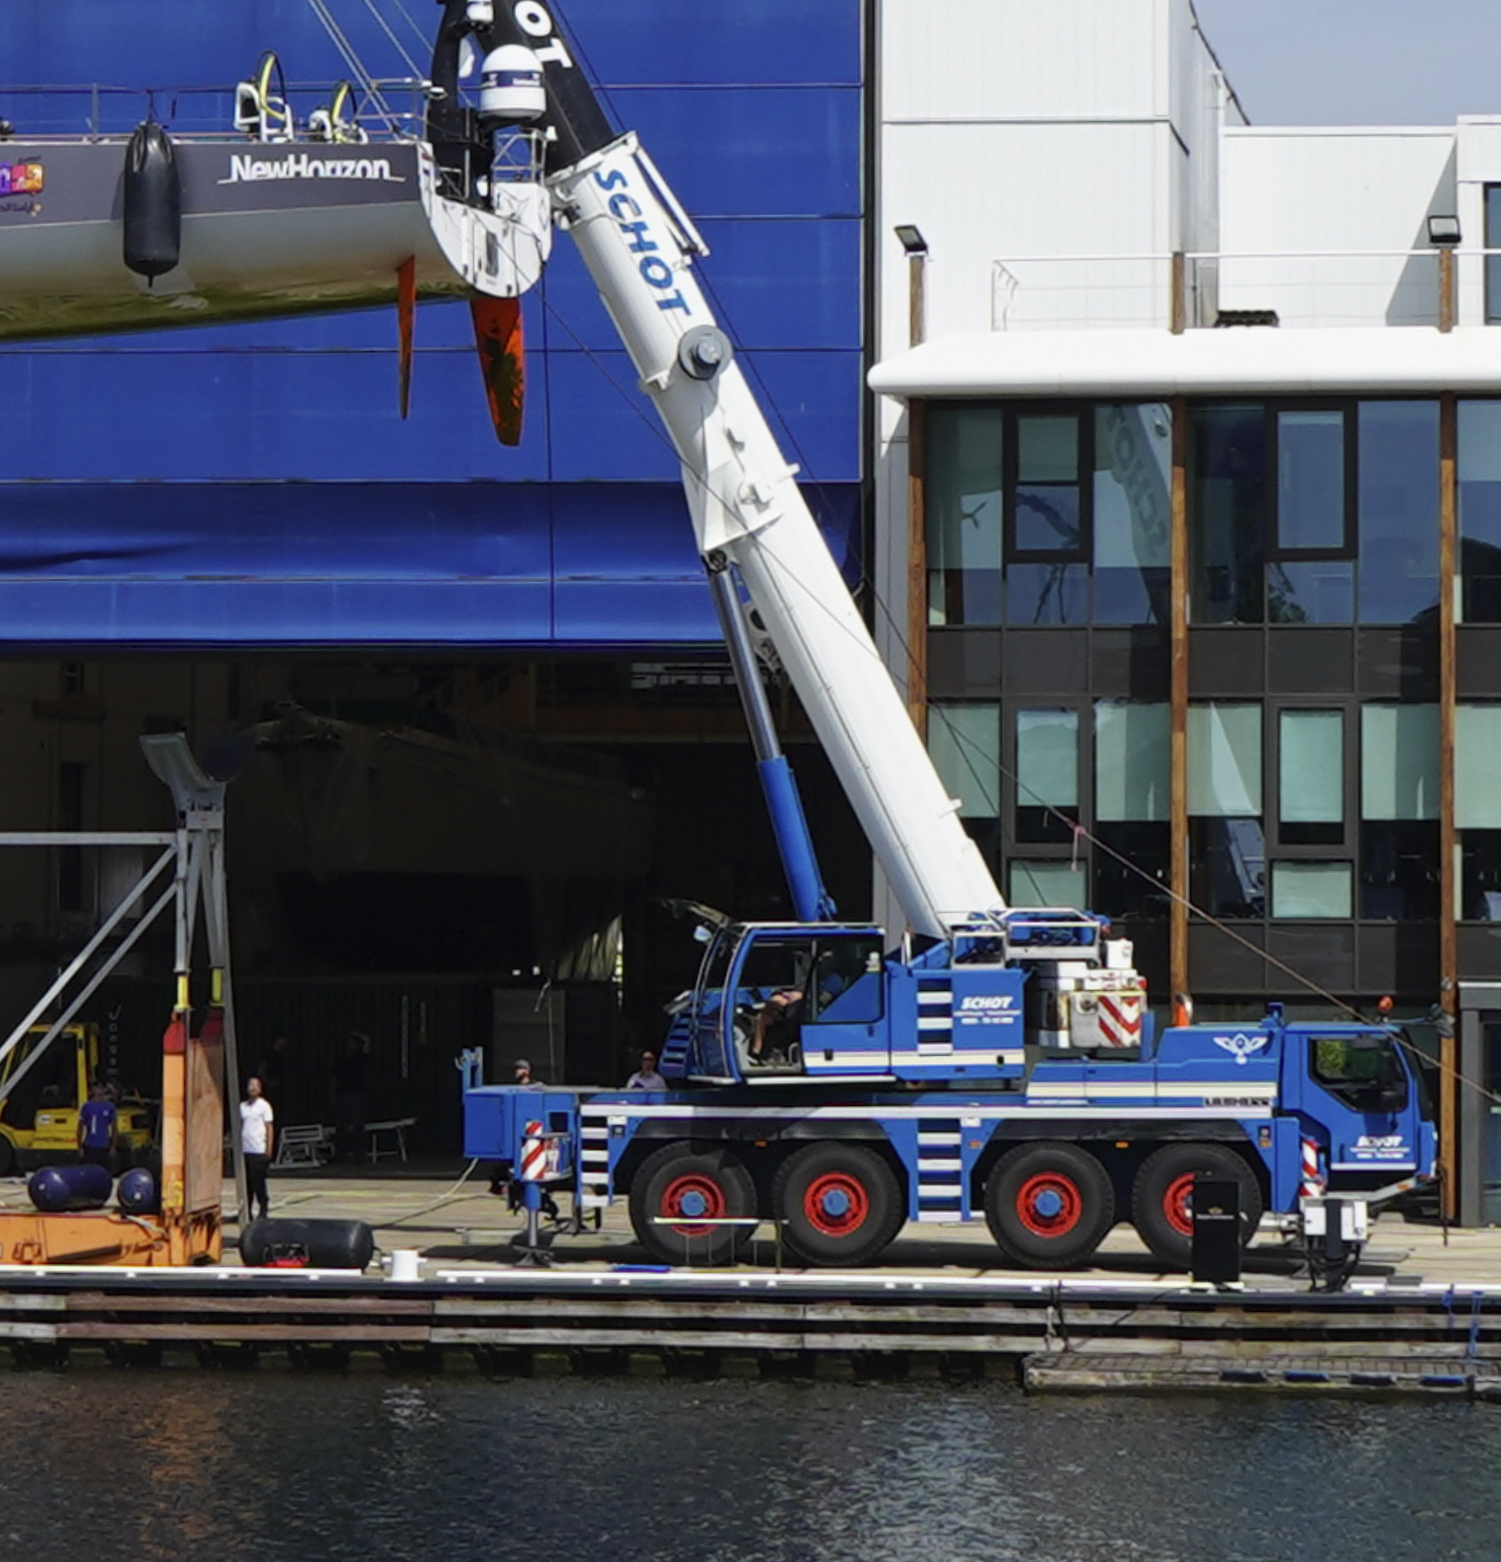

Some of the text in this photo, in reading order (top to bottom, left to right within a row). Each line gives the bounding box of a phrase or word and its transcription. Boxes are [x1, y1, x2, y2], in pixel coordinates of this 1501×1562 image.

[229, 153, 393, 183] NewHorizon
[594, 167, 692, 317] SCHOT
[960, 995, 1014, 1010] SCHOT
